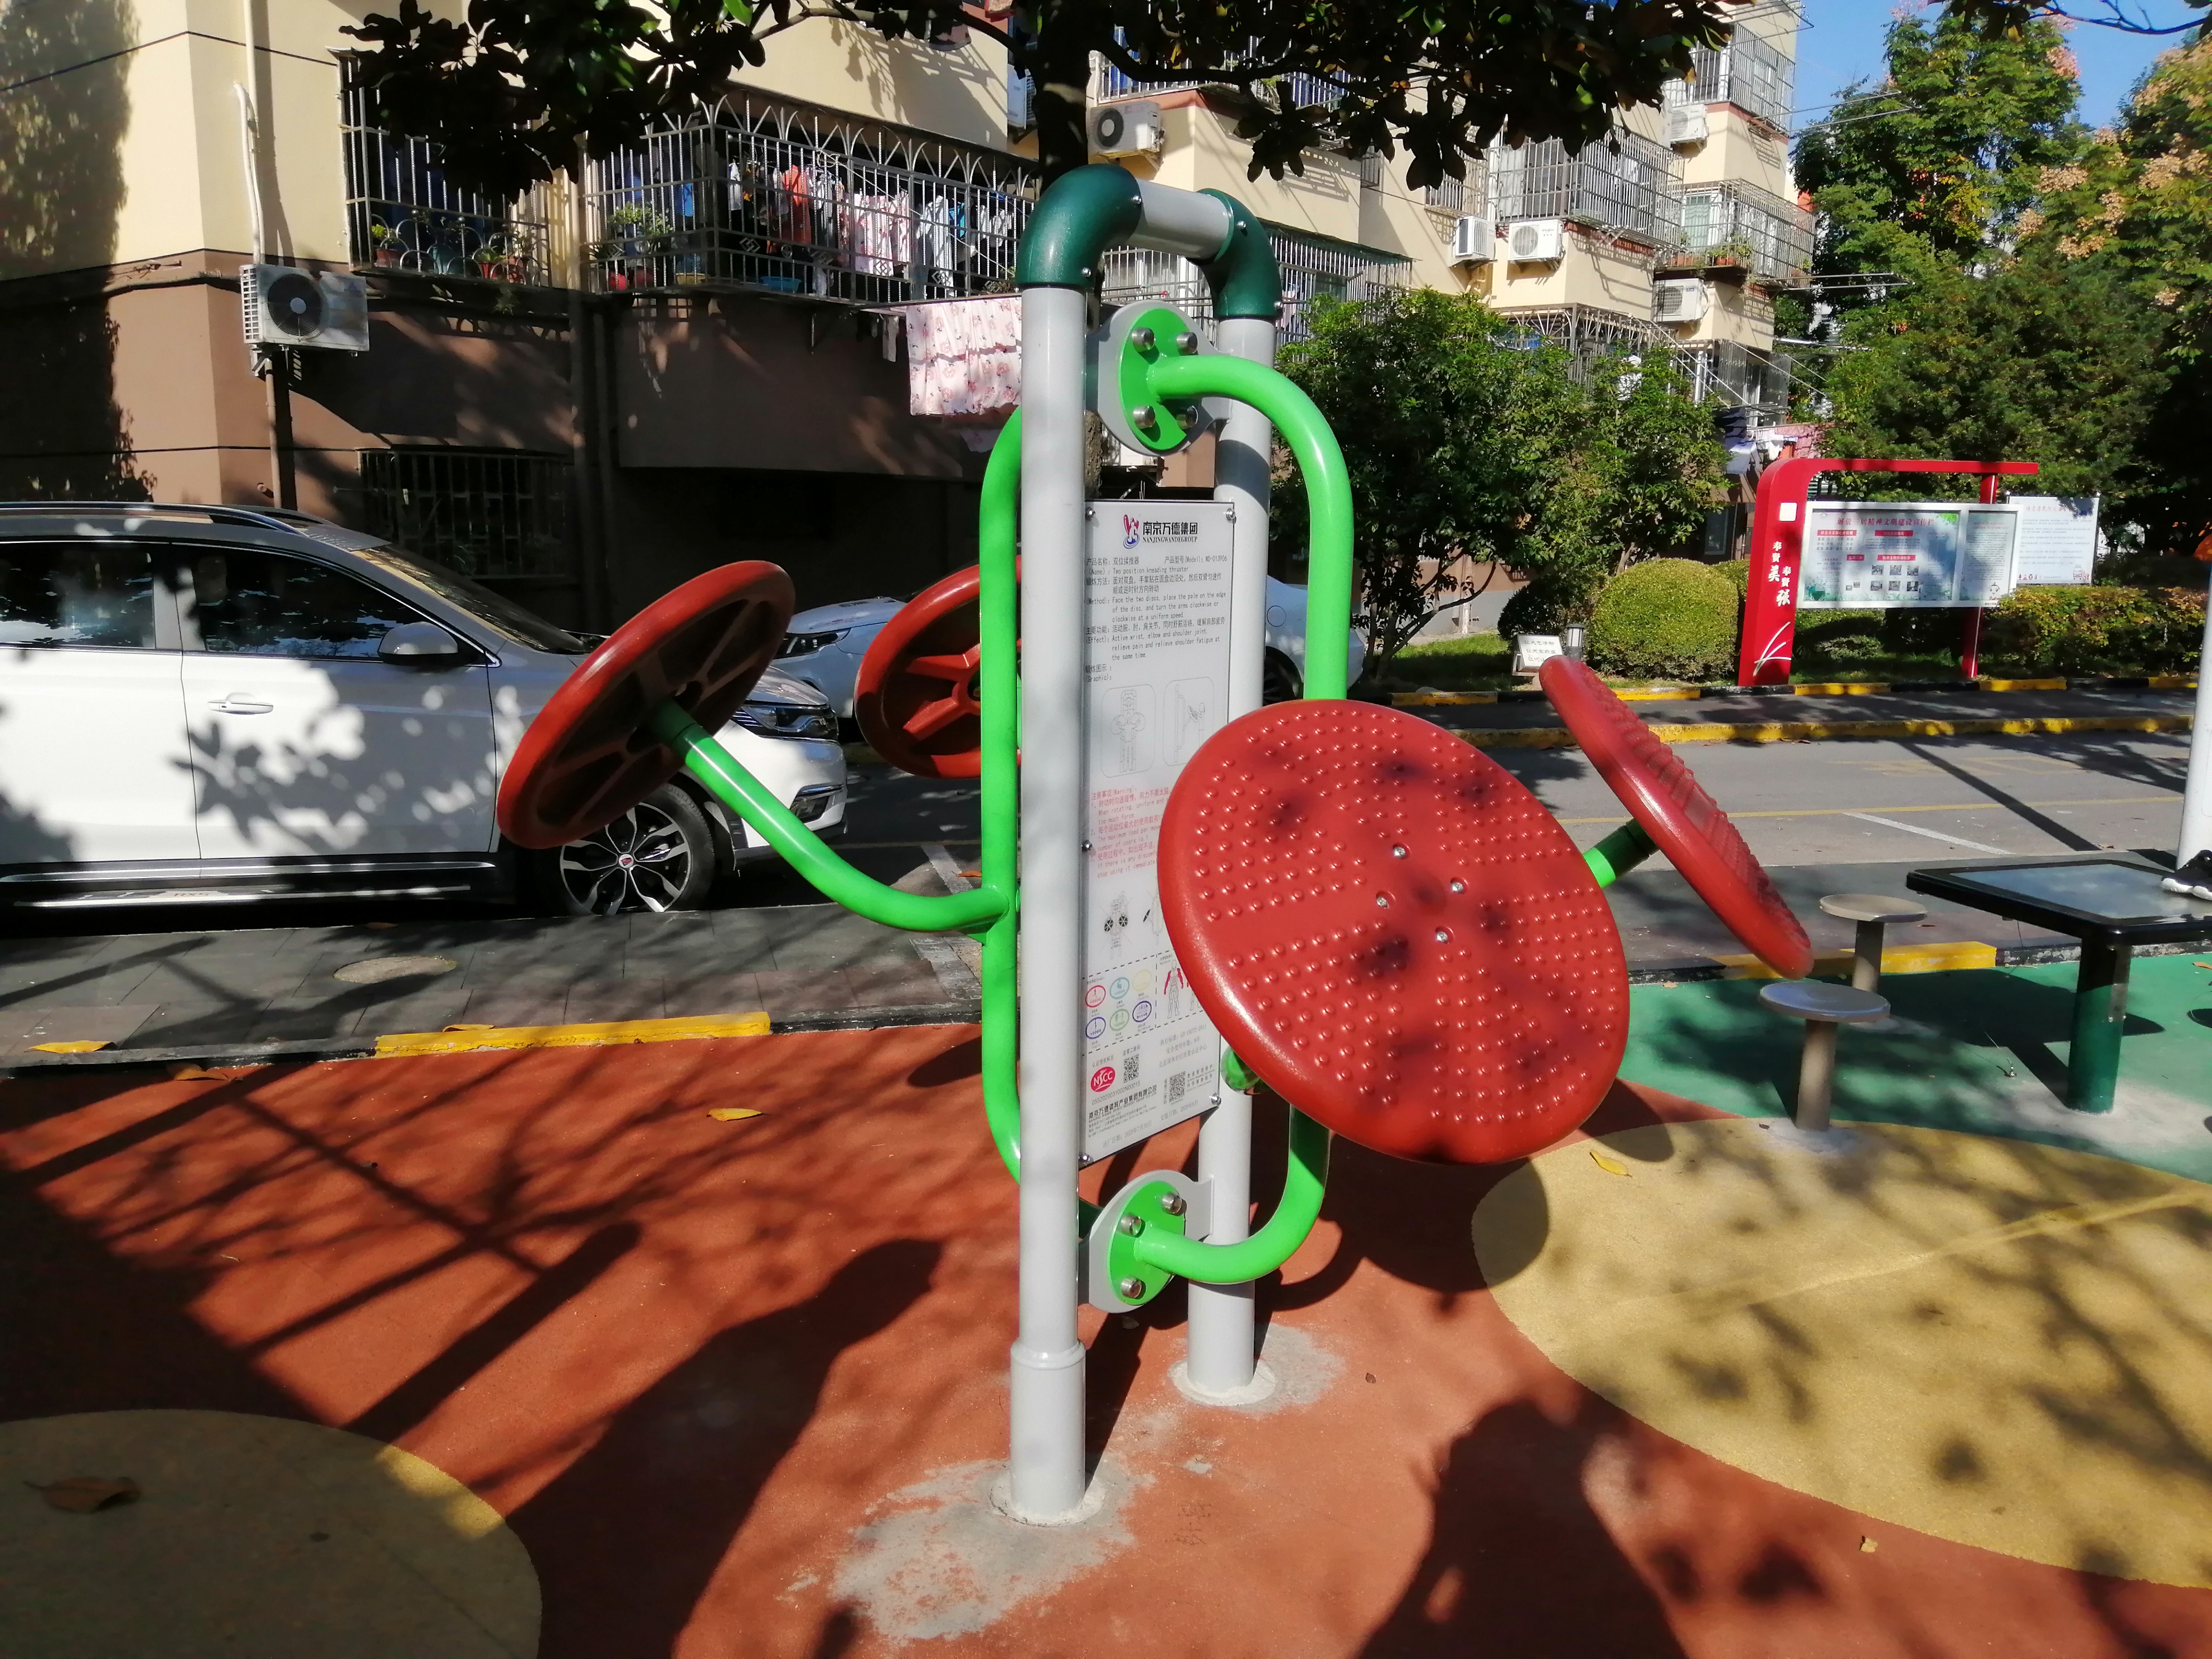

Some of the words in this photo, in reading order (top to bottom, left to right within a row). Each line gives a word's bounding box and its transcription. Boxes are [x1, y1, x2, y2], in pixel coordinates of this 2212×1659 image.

[1143, 521, 1198, 535] 南京万德集团
[1123, 567, 1144, 576] position
[1136, 800, 1154, 808] uniform
[1108, 832, 1127, 840] maximum
